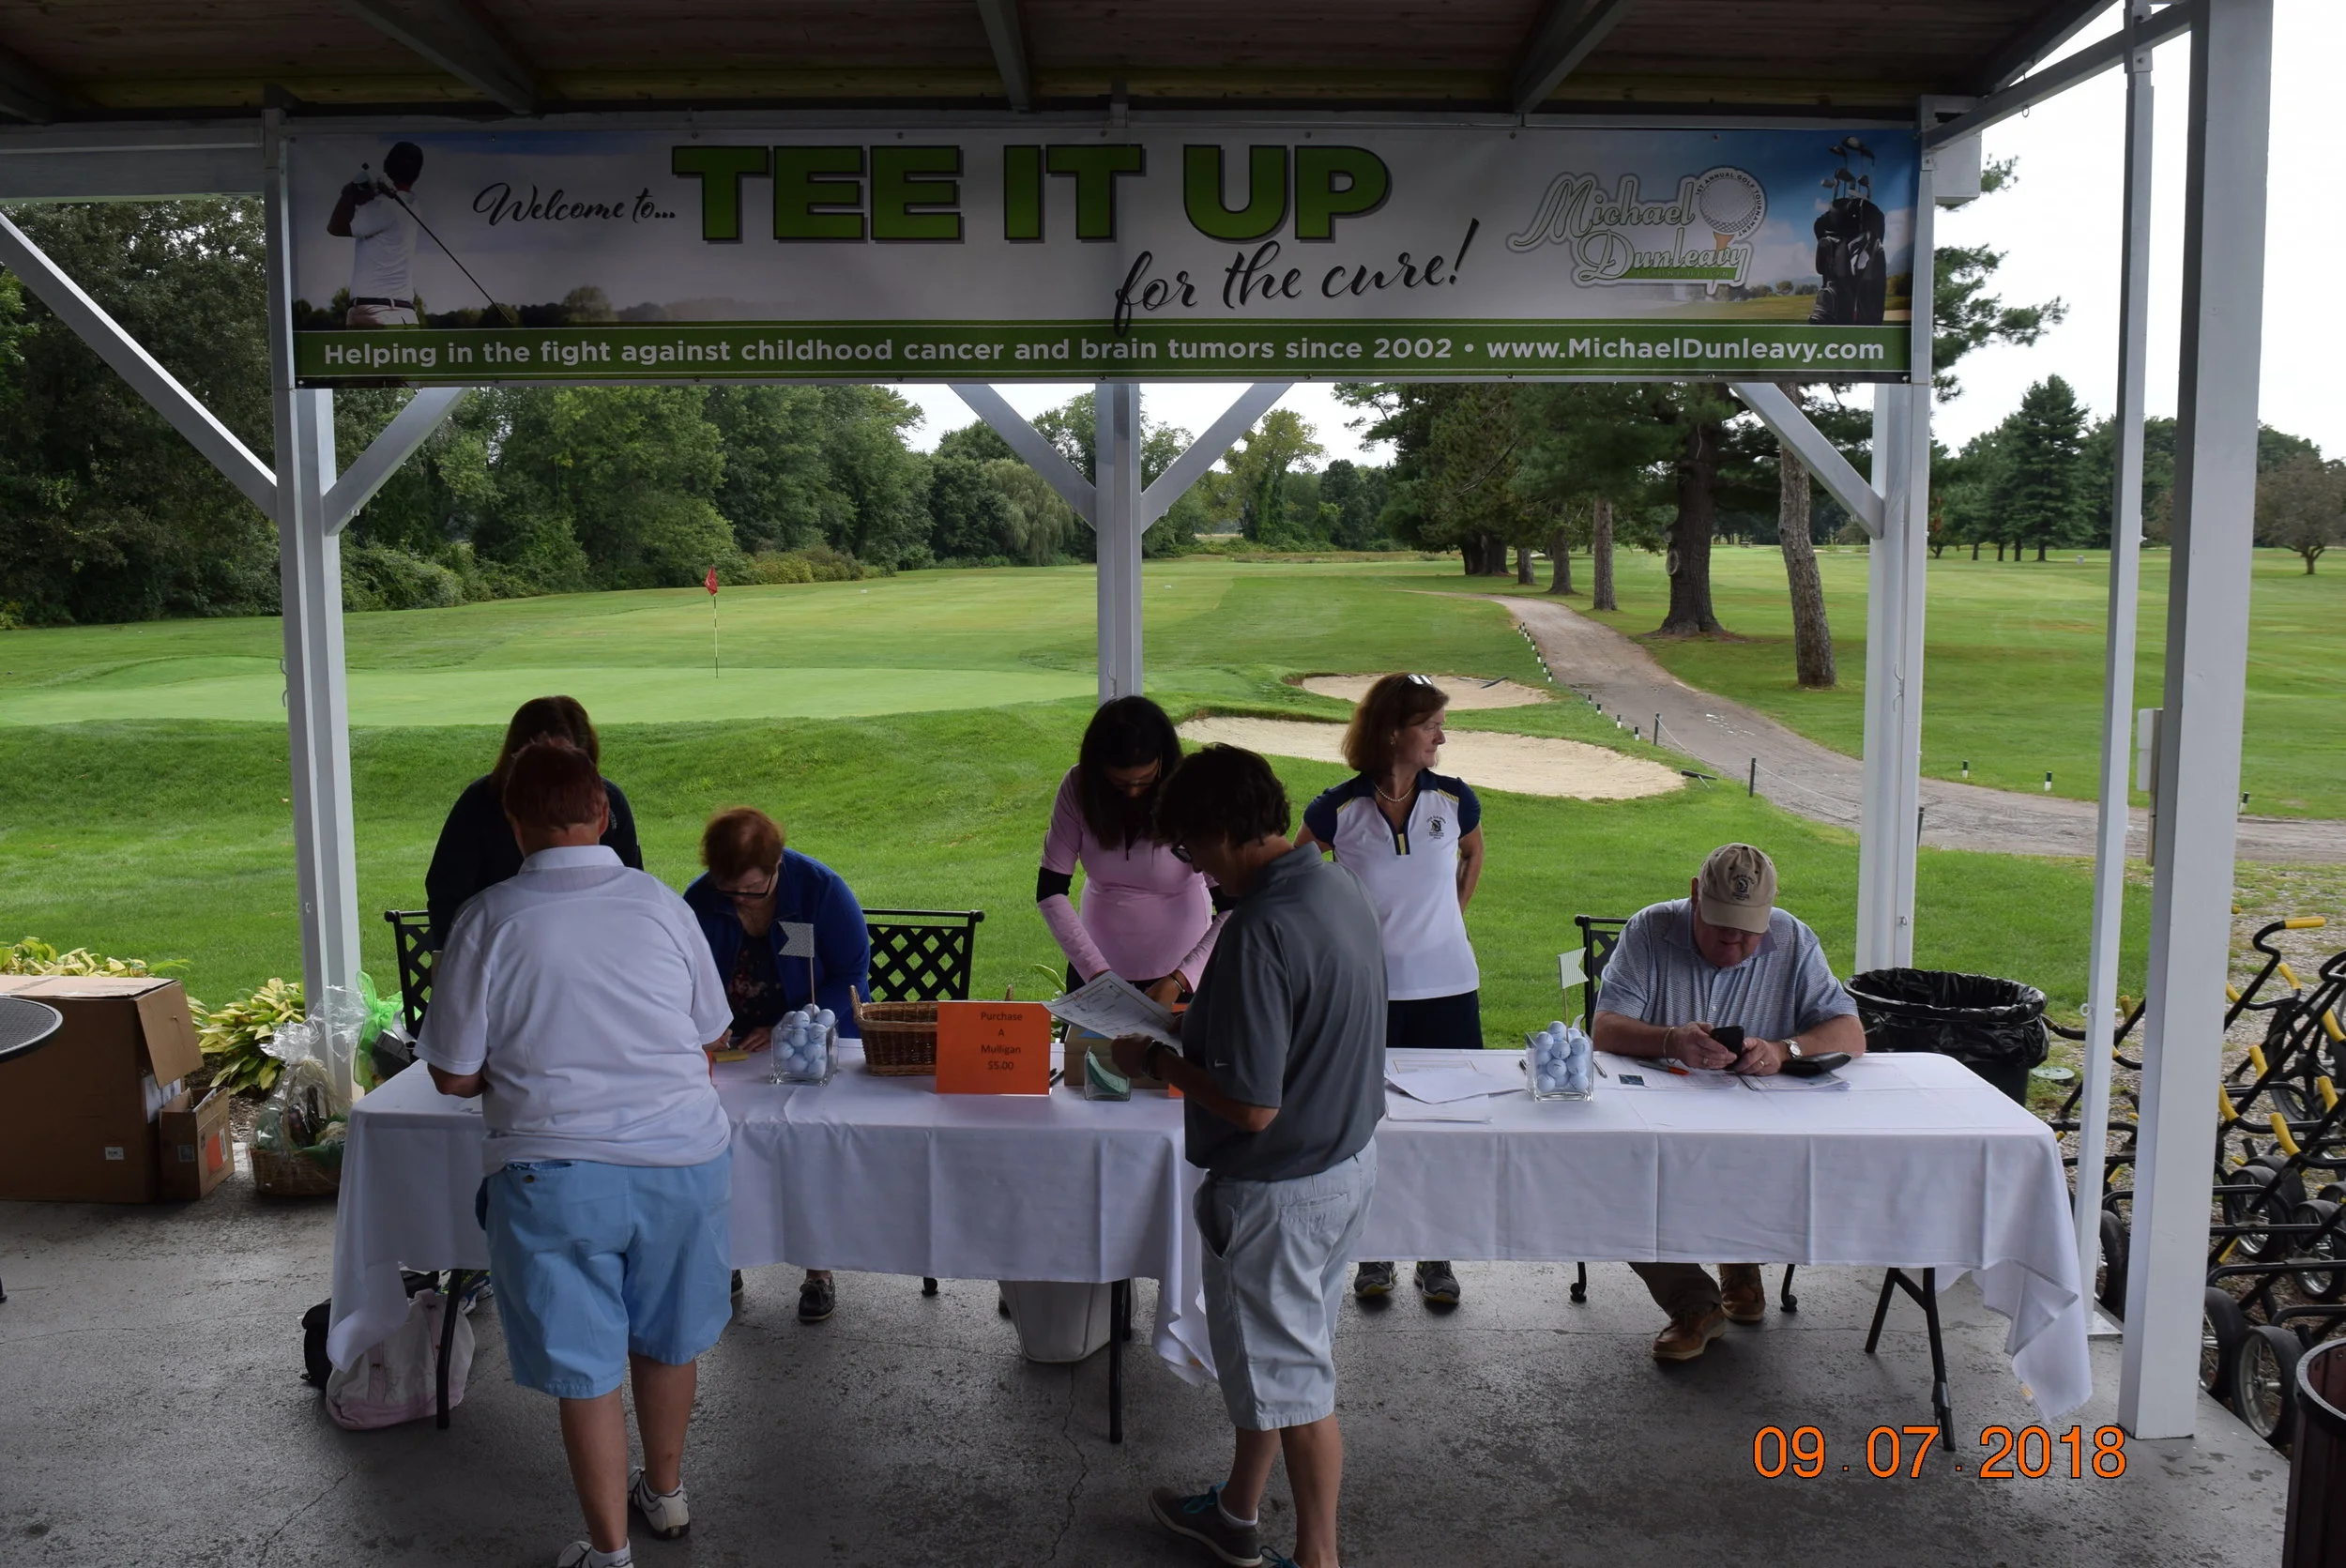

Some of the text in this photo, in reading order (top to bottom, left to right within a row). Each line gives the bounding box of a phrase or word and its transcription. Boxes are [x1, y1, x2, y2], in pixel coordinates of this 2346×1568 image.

[472, 182, 676, 226] Welcome to...
[671, 144, 1393, 243] TEE IT UP
[1513, 179, 1696, 247] Michael
[1695, 173, 1762, 237] 1ST ANNUAL GOLF TOURNAMENT
[1577, 228, 1748, 282] Dunleavy
[1113, 218, 1480, 337] for the cure!
[325, 338, 1884, 368] Helping in the fight against childhood cancer and brain tumors since 2002 www.MichaelDunleavy.com
[981, 1012, 1023, 1021] Purchase
[998, 1028, 1005, 1037] A
[981, 1044, 1021, 1056] Mulligan
[987, 1060, 1014, 1071] $5.00
